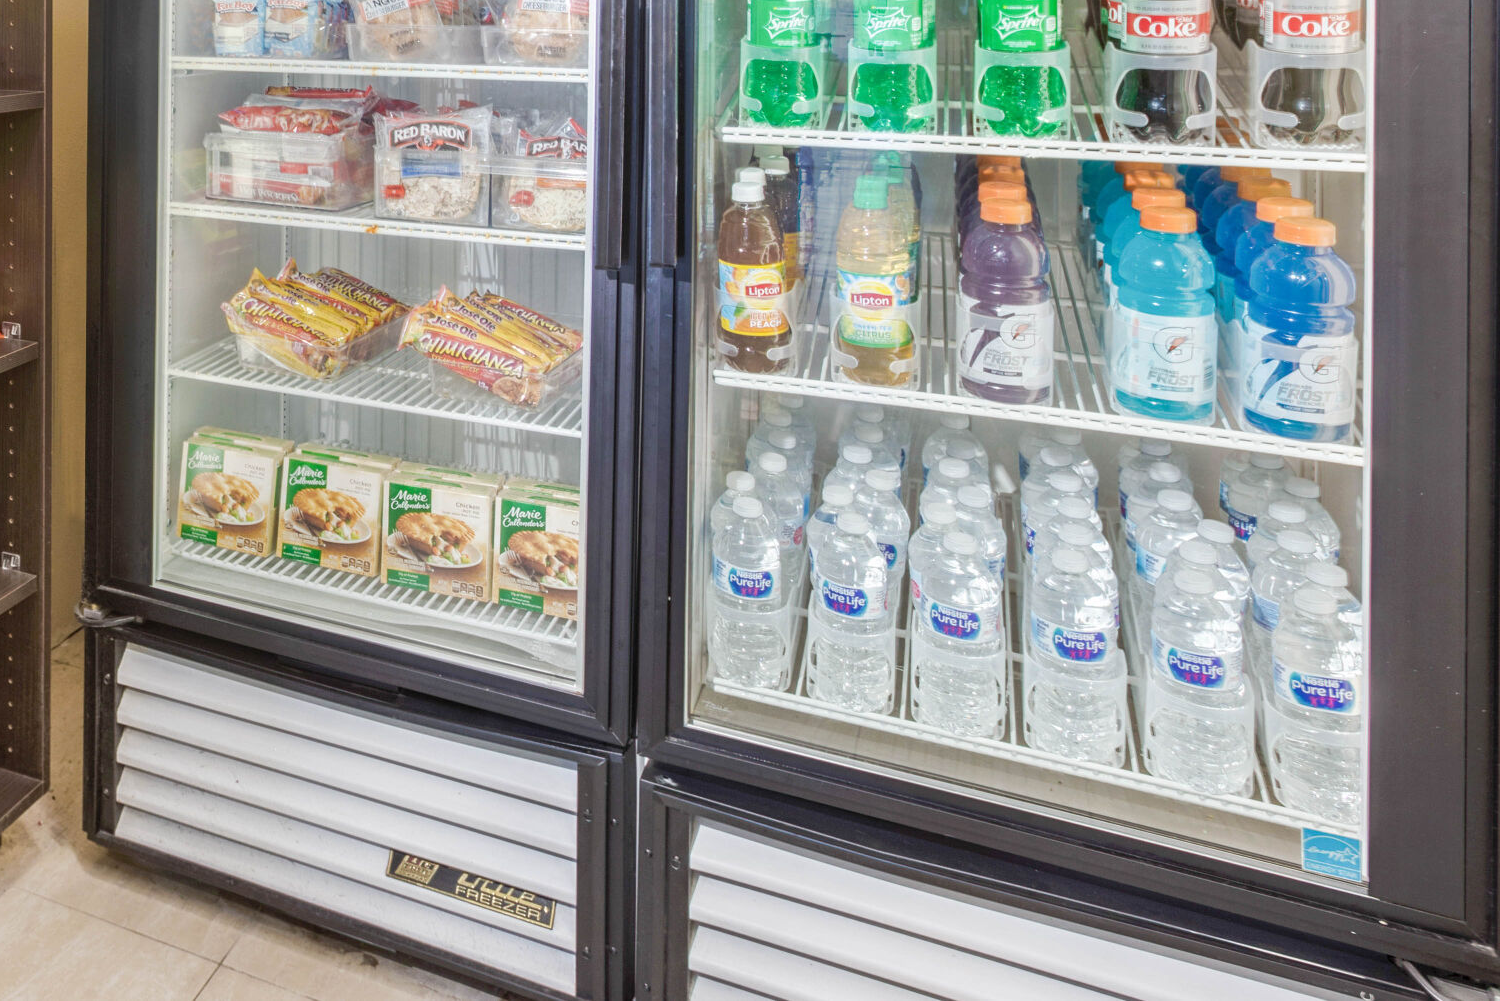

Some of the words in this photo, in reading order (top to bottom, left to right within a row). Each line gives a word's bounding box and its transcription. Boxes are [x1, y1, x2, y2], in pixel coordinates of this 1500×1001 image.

[767, 15, 808, 32] Sprite
[867, 13, 907, 31] Sprite
[999, 13, 1041, 31] Sprite
[1133, 16, 1197, 37] Coke
[1282, 15, 1350, 36] Coke
[393, 124, 418, 141] RED
[419, 123, 466, 142] BARON
[560, 138, 587, 155] BAR
[748, 285, 781, 298] Lipton
[853, 293, 890, 307] Lipton
[749, 318, 782, 329] PEACH
[854, 329, 892, 340] CITRUS
[418, 334, 524, 380] CHIMICHANGA
[1147, 369, 1200, 387] FROST
[1277, 385, 1334, 403] FROST
[288, 464, 325, 480] Marie
[392, 489, 428, 502] Marie
[503, 506, 543, 520] Marie
[729, 577, 754, 590] Pure
[755, 578, 772, 591] Life
[822, 590, 845, 605] Pure
[846, 595, 868, 610] Life
[931, 610, 957, 628] Pure
[959, 617, 981, 633] Life
[1053, 636, 1085, 652] Pure
[1086, 637, 1107, 653] Life
[1168, 657, 1199, 675] Pure
[1201, 663, 1225, 680] Life
[1292, 681, 1325, 700] Pure
[1327, 685, 1354, 703] Life
[455, 885, 541, 922] FREEZER
